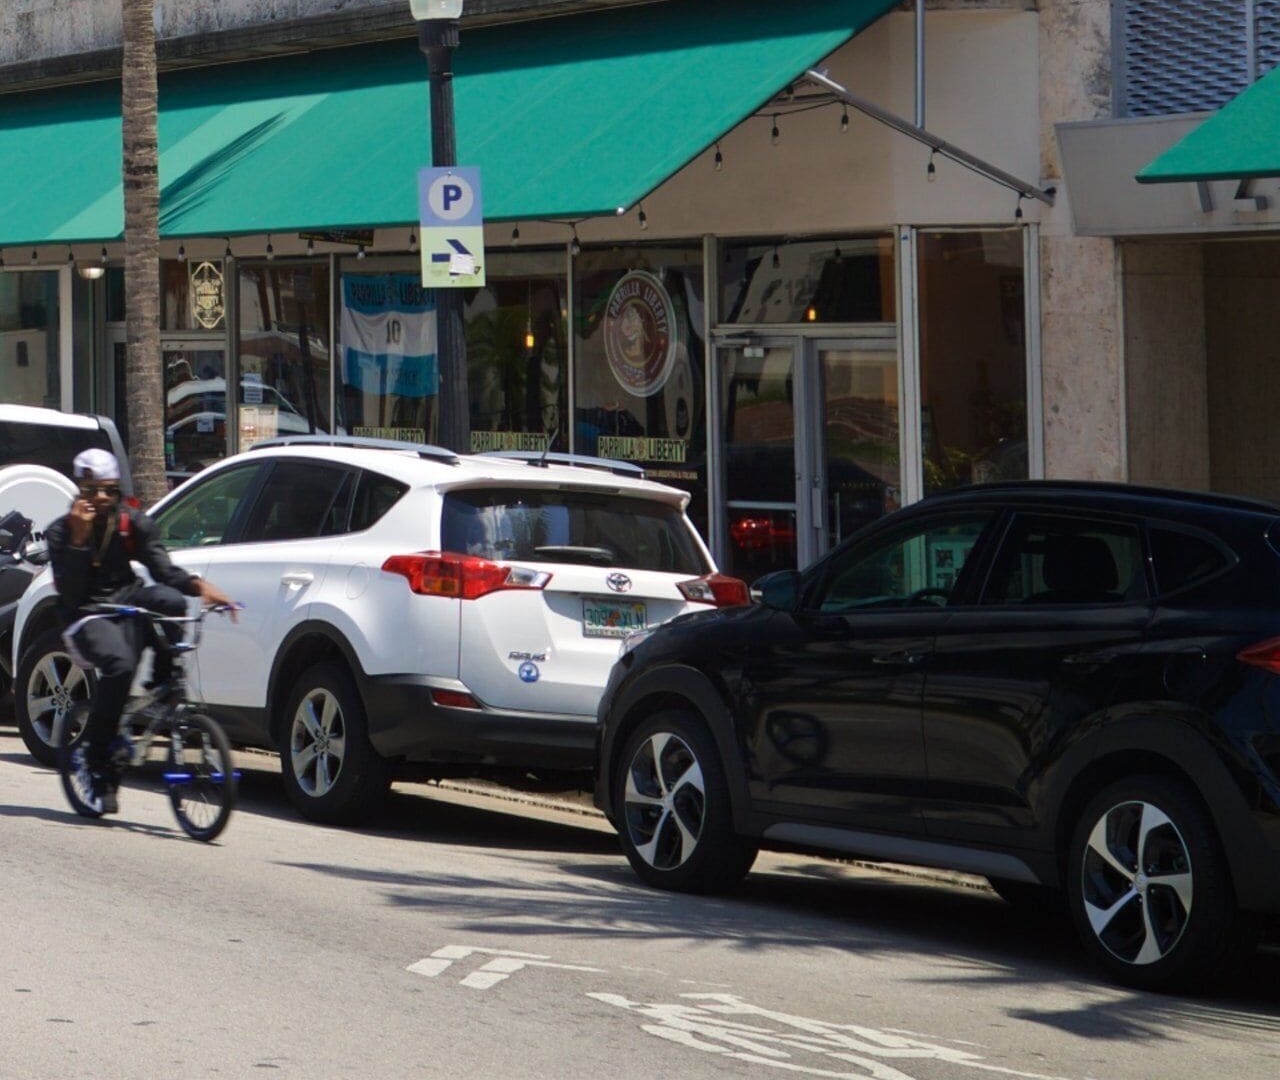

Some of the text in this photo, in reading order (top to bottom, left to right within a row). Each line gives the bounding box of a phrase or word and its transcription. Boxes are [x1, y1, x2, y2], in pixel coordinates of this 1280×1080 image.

[443, 184, 463, 211] P
[386, 319, 402, 344] 10
[599, 437, 685, 461] PARRILLA LIBERTY
